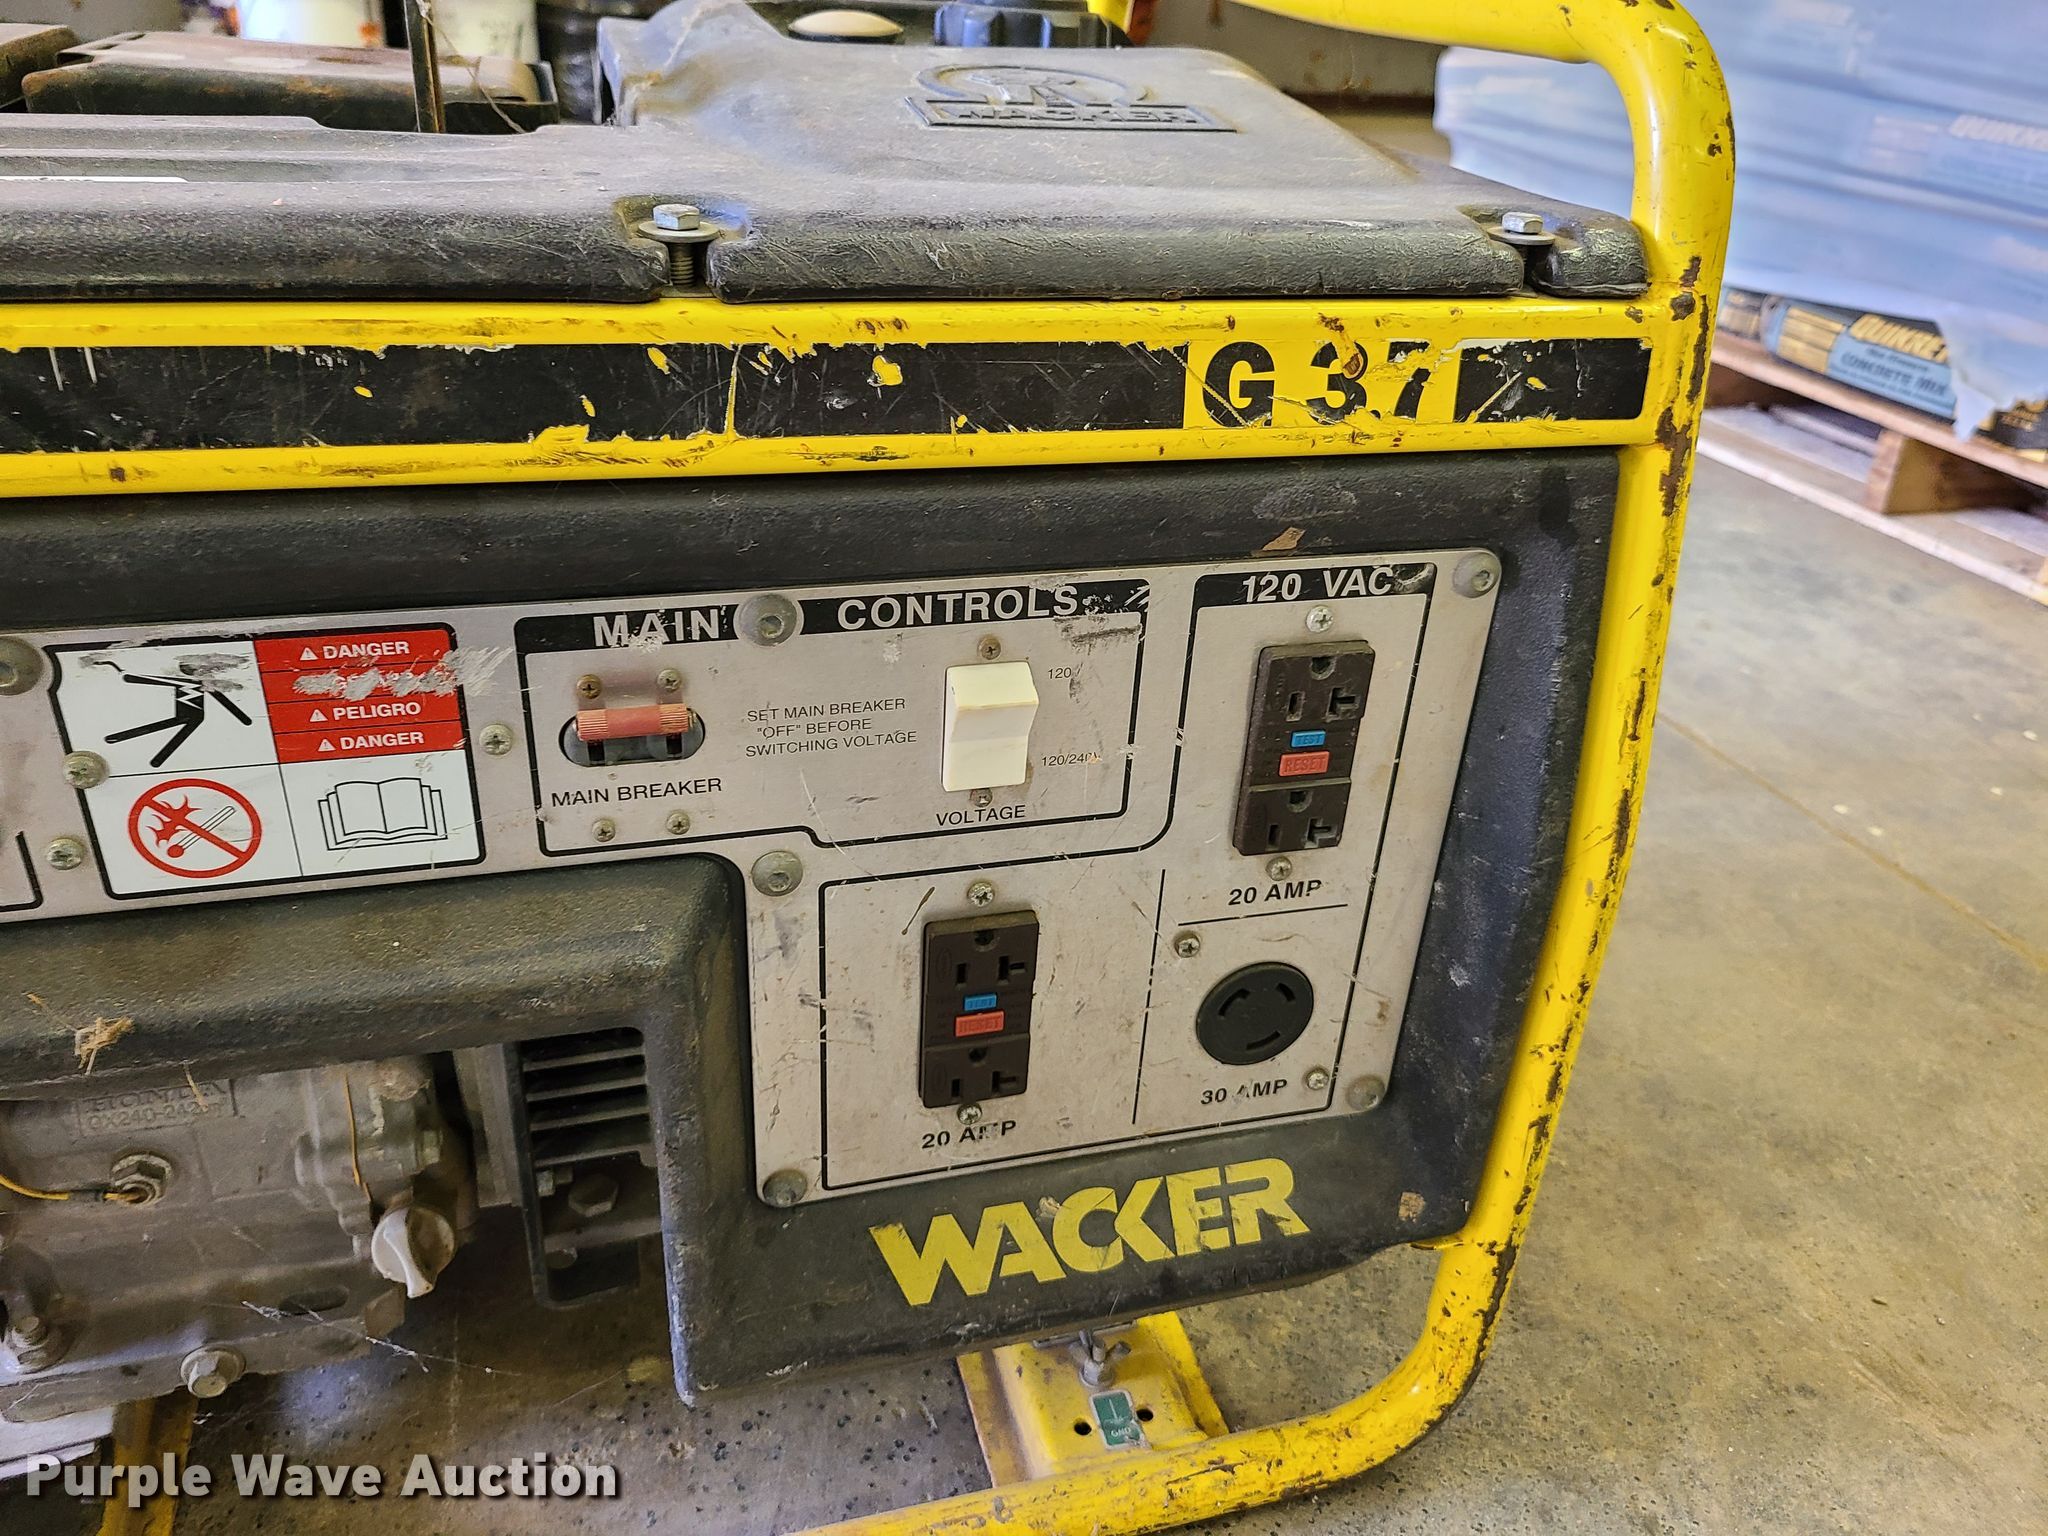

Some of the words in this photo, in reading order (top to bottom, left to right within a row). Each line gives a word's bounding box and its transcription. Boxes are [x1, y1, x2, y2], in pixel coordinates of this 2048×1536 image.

[1202, 340, 1276, 429] G
[1304, 338, 1434, 424] 37
[1242, 572, 1302, 603] 120
[1322, 567, 1395, 597] VAC
[593, 608, 720, 648] MAIN
[837, 585, 1079, 631] CONTROLS
[322, 640, 410, 660] DANGER
[332, 702, 422, 721] PELIGRO
[747, 708, 779, 722] SET
[785, 704, 825, 719] MAIN
[830, 698, 906, 715] BREAKER
[757, 724, 801, 740] "OFF"
[806, 718, 873, 735] BEFORE
[1295, 732, 1324, 746] TEST
[340, 731, 425, 750] DANGER
[745, 738, 838, 758] SWITCHING
[842, 731, 918, 748] VOLTAGE
[1283, 755, 1328, 773] RESET
[551, 787, 610, 808] MAIN
[617, 777, 723, 801] BREAKER
[935, 805, 1026, 828] VOLTAGE
[1228, 887, 1258, 906] 20
[1264, 879, 1323, 902] AMP
[958, 1014, 1003, 1034] RESET
[1200, 1087, 1227, 1105] 30
[921, 1130, 951, 1149] 20
[868, 1157, 1311, 1306] WACKER
